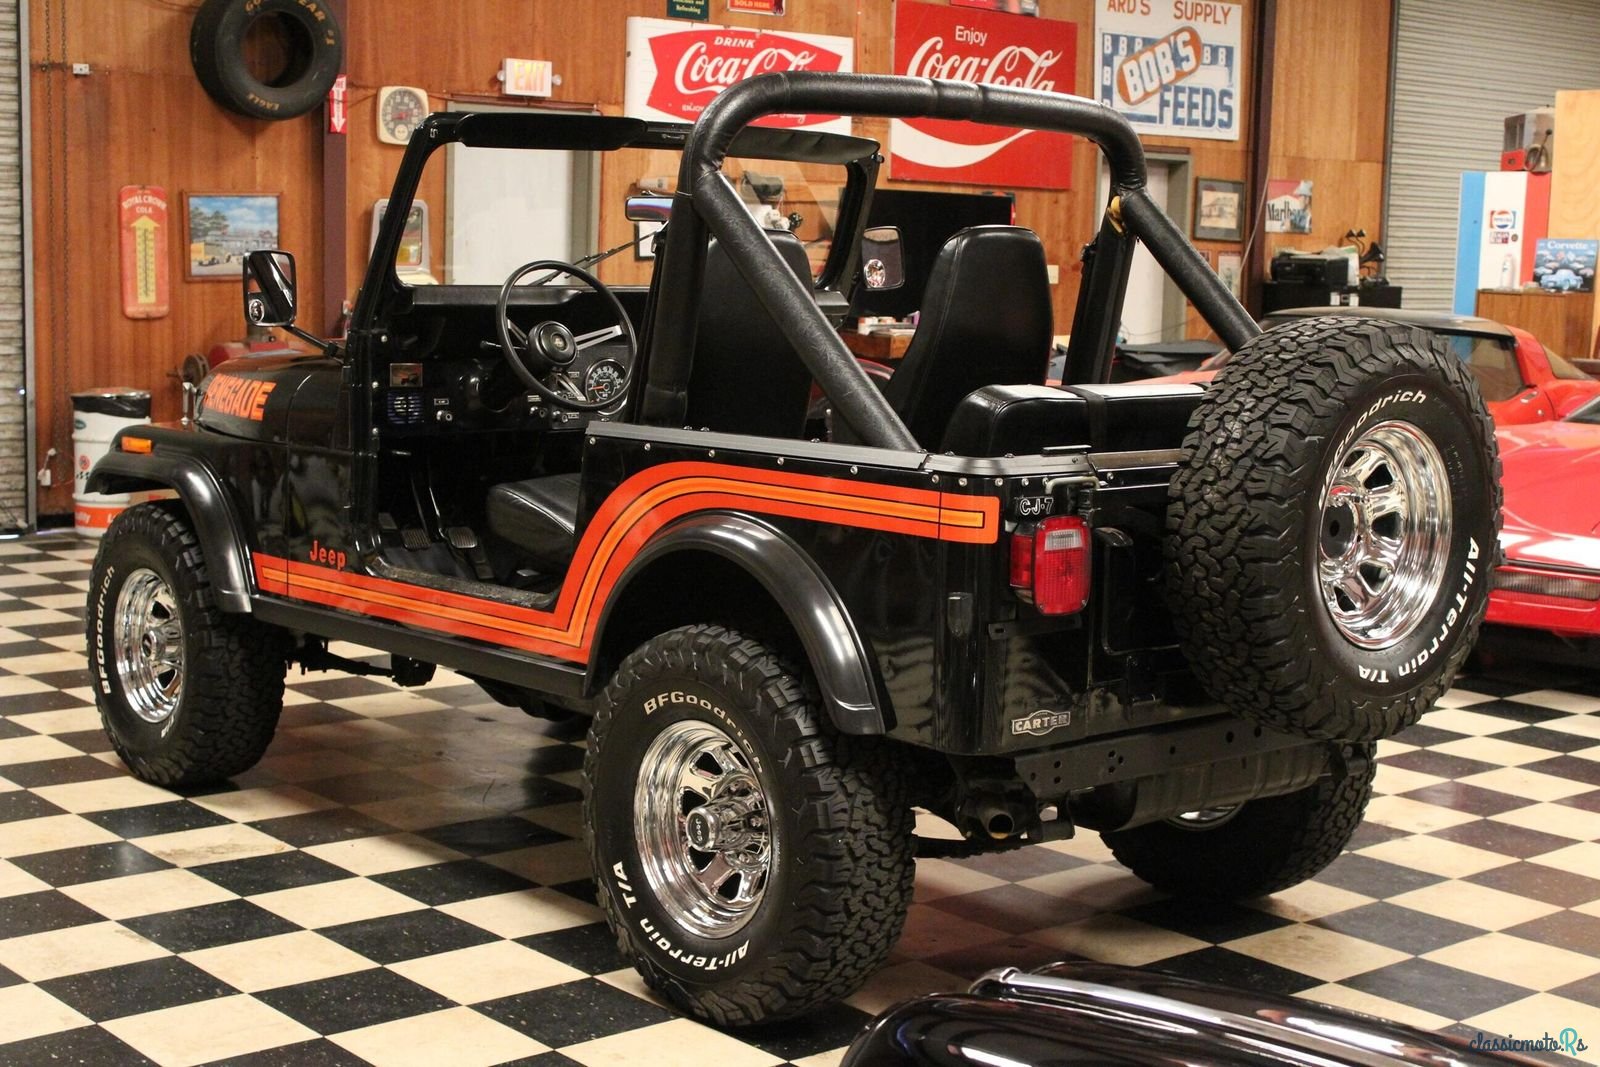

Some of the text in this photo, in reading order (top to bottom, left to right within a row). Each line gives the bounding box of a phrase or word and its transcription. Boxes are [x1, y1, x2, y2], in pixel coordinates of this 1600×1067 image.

[1173, 0, 1232, 25] SUPPLY
[713, 36, 756, 49] DRINK
[955, 25, 988, 47] Enjoy
[514, 61, 545, 92] EXIT
[674, 41, 817, 95] Coca-C
[1121, 31, 1197, 103] BOB'S
[1158, 85, 1233, 130] FEEDS
[1546, 240, 1589, 250] Corvette
[310, 539, 346, 570] Jeep
[96, 565, 116, 695] BFGoodrich
[1358, 536, 1480, 683] All-Terrain T/A
[643, 690, 763, 774] BFGoodrich
[613, 861, 750, 971] All-Terrain T/A
